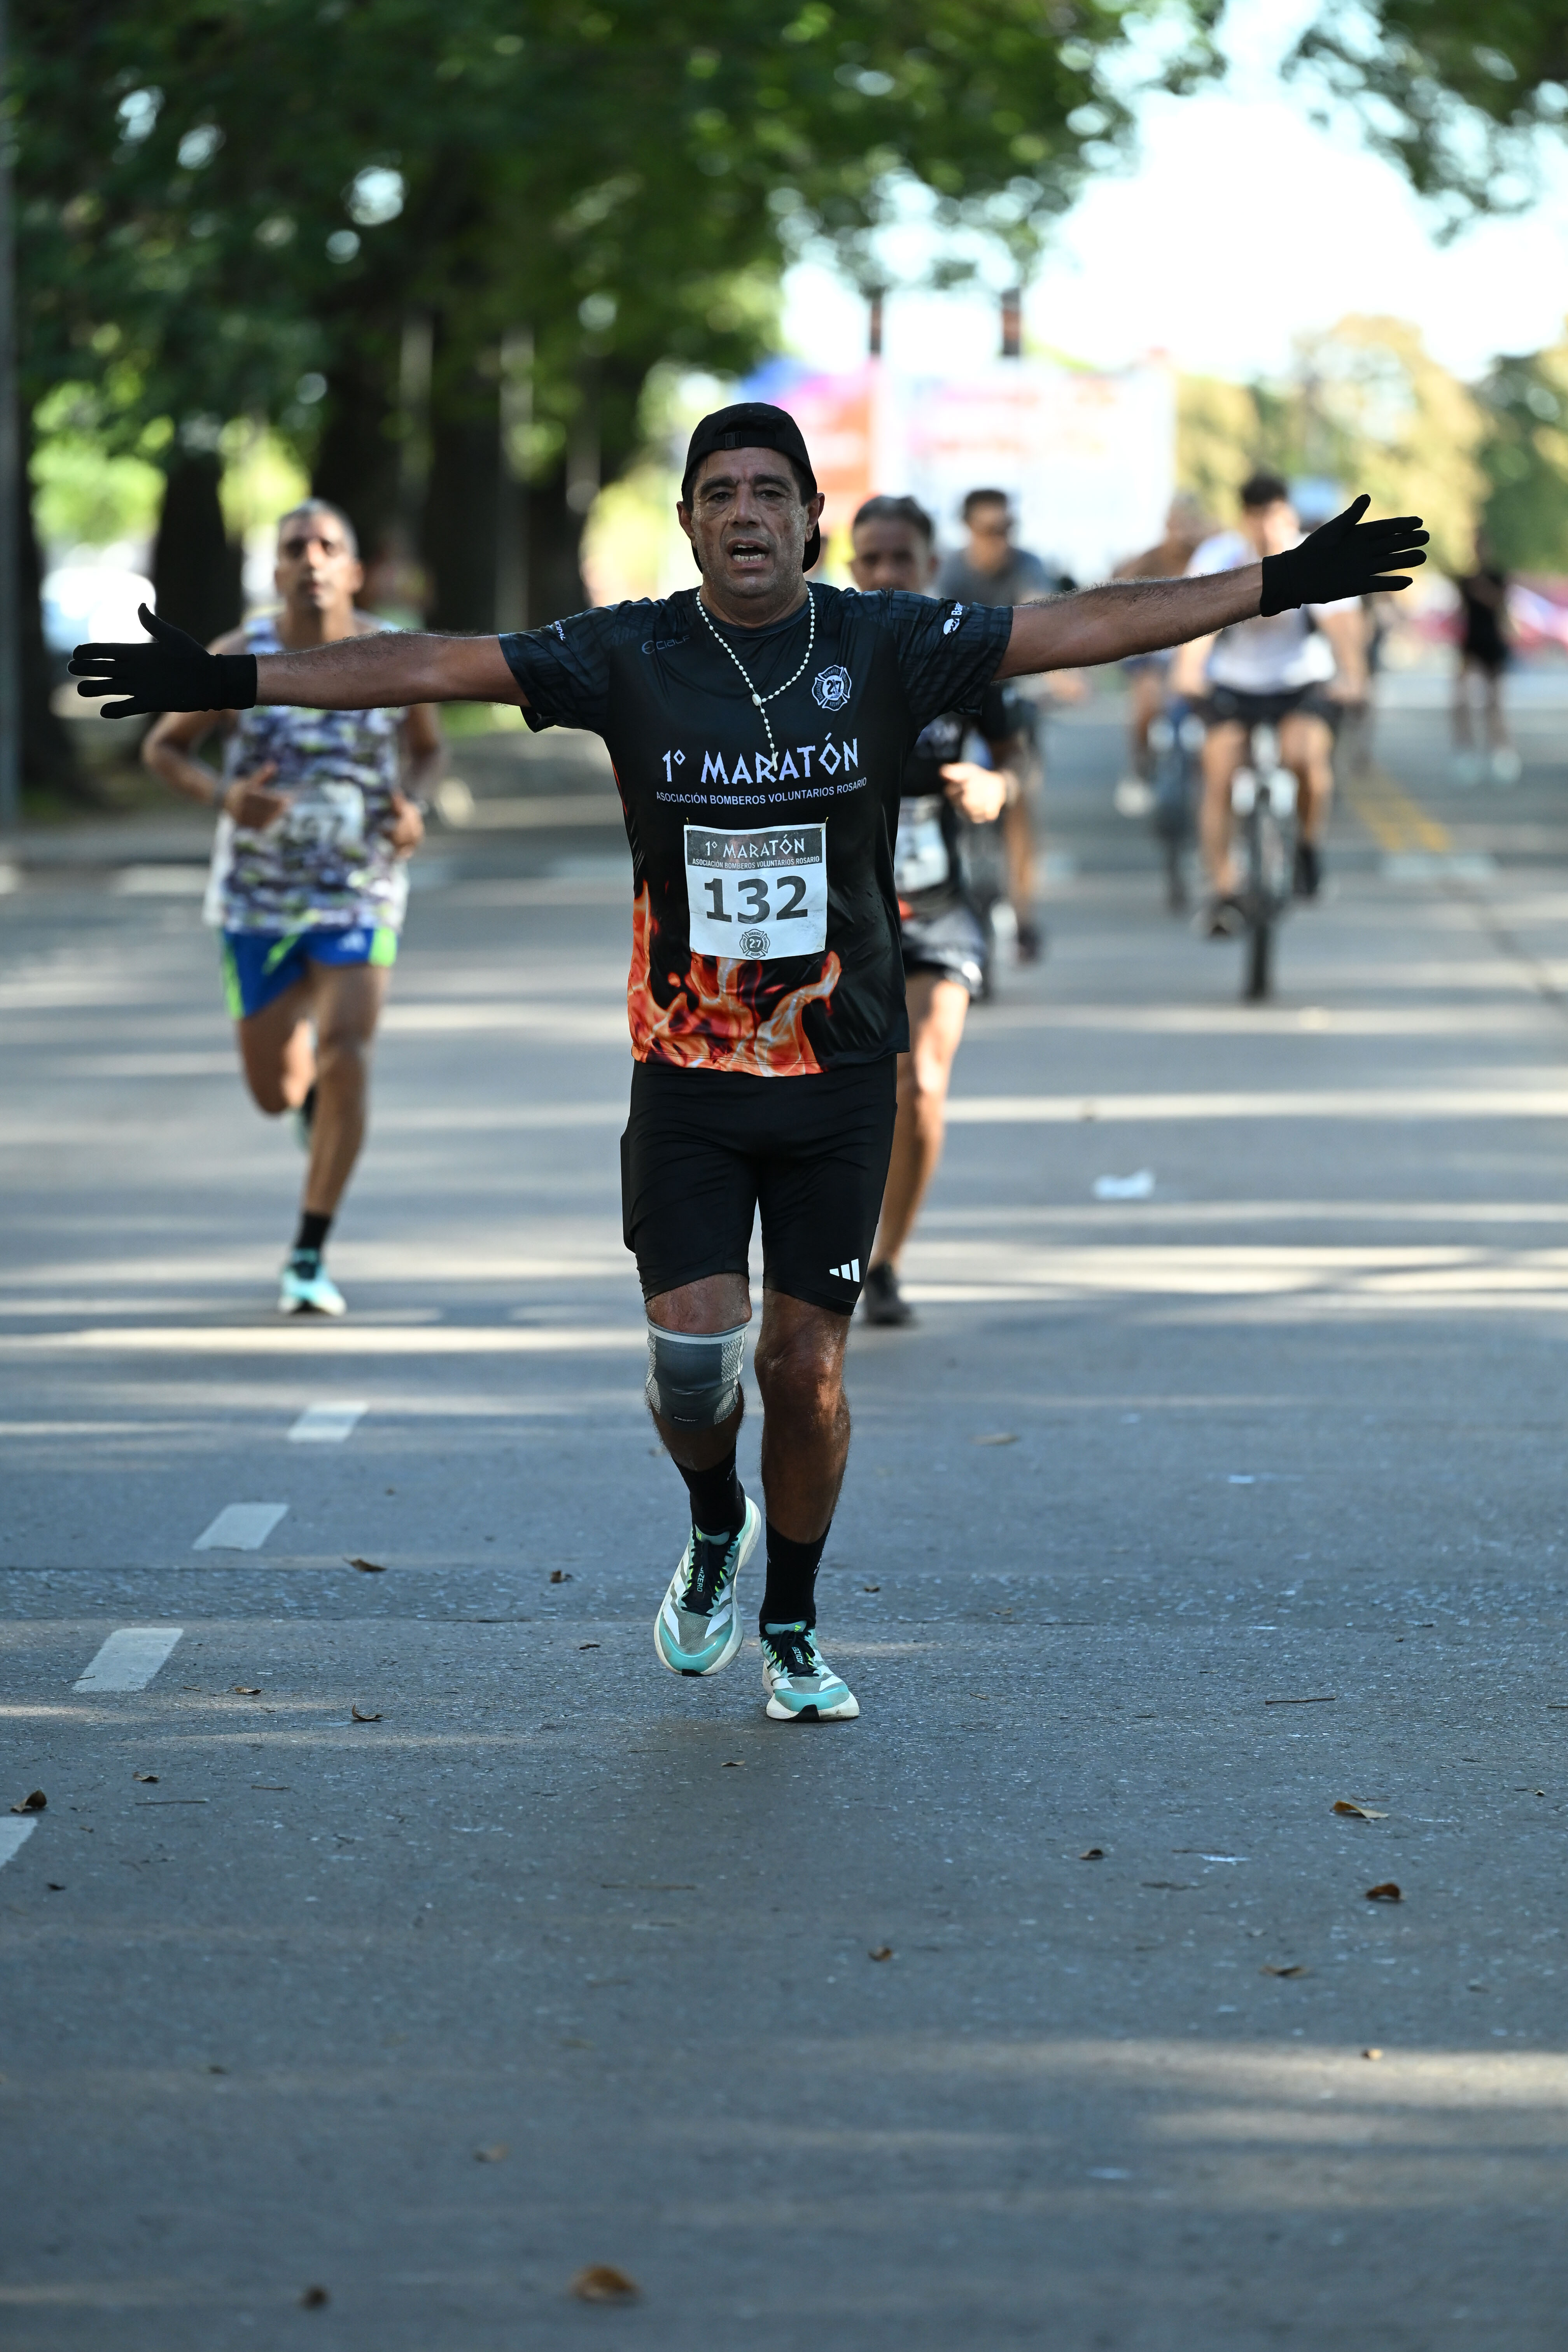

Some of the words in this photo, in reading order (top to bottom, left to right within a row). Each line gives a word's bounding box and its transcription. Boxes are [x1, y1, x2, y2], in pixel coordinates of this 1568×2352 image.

[826, 680, 842, 695] 27
[700, 732, 858, 784] MARATÓN
[656, 791, 707, 804] ASOCIACIÓN
[710, 794, 766, 805] BOMBEROS
[768, 786, 835, 803] VOLUNTARIOS
[836, 777, 867, 794] ROSARIO
[723, 834, 805, 859] MARATÓN
[692, 858, 723, 868] ASOCIACIÓN
[757, 859, 794, 868] VOLUNTARIOS
[796, 856, 820, 865] ROSARIO
[704, 876, 808, 924] 132
[749, 938, 761, 948] 27
